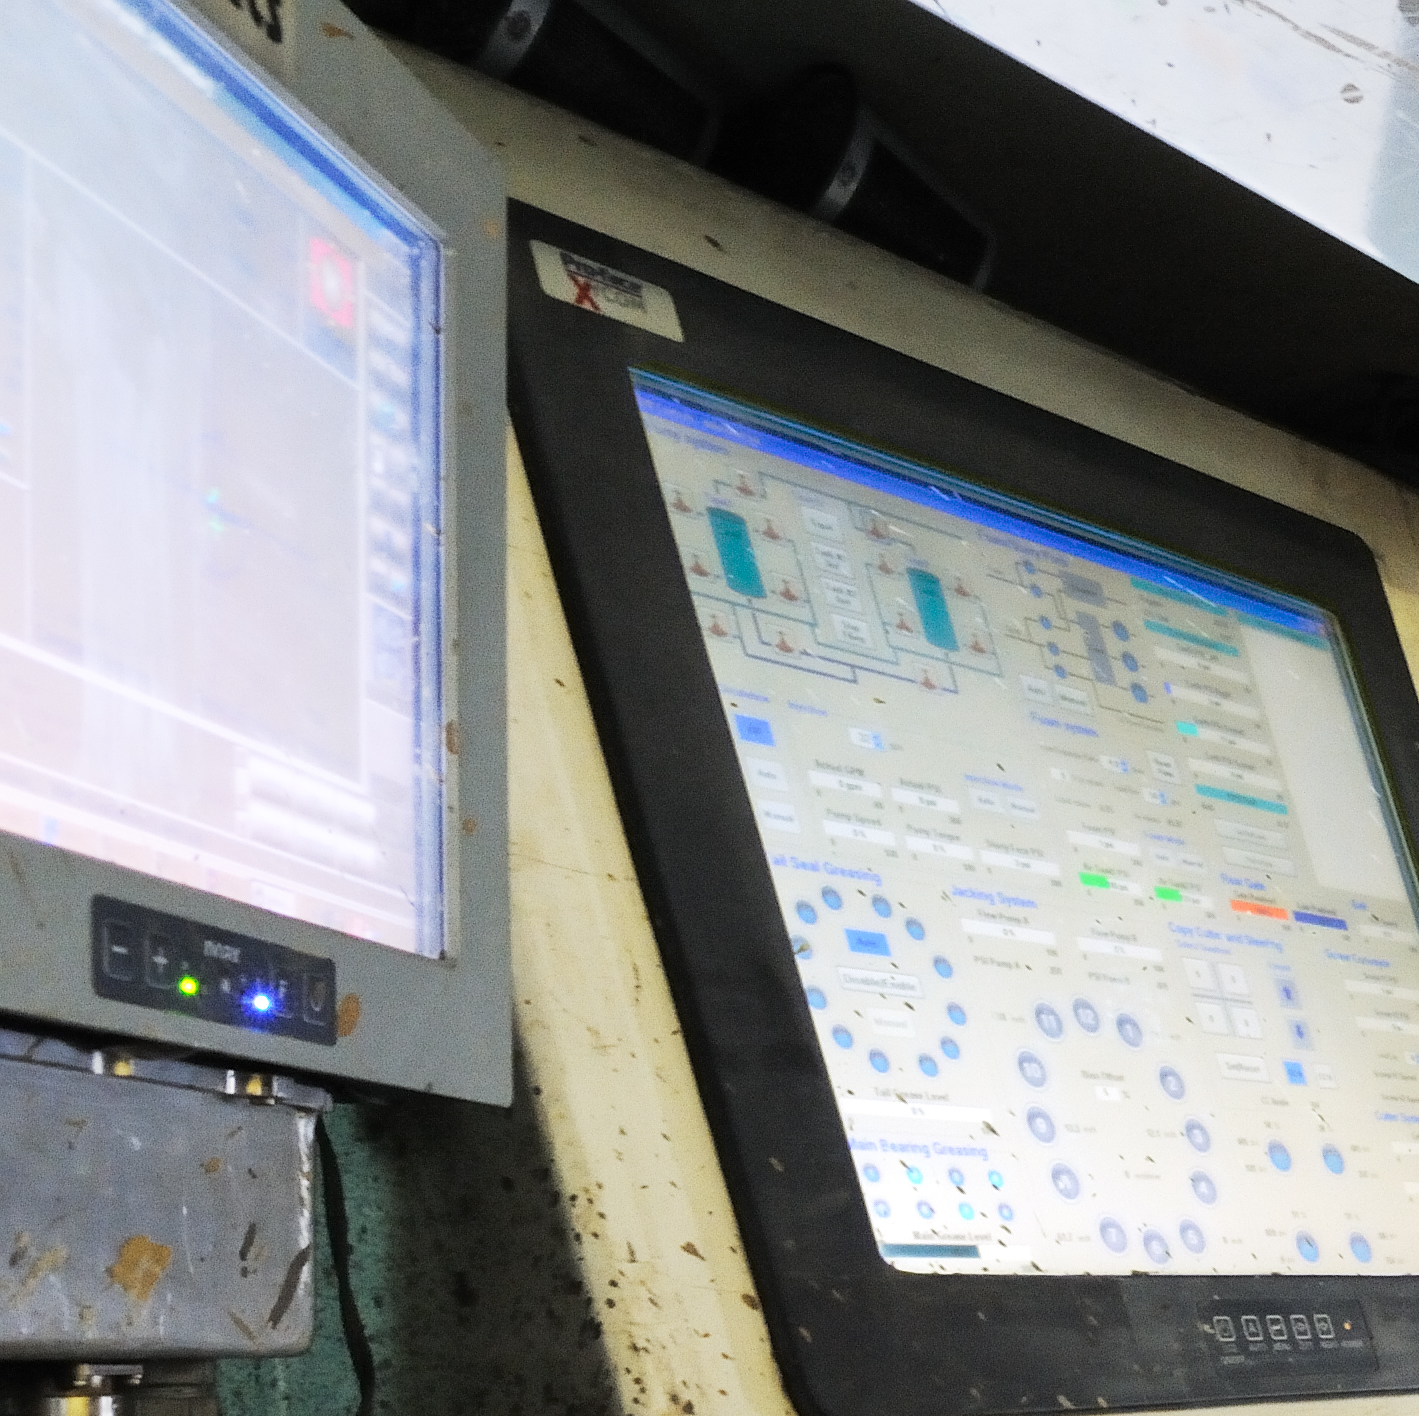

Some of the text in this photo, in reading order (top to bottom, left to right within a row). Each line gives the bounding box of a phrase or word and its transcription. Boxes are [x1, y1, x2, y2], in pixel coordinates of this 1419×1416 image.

[768, 852, 884, 888] ail Seal Greasing
[949, 884, 1039, 910] Jacking System
[1040, 1013, 1059, 1028] 11
[1074, 1006, 1095, 1024] 12
[1021, 1061, 1042, 1078] 10
[1166, 1075, 1179, 1091] 2
[925, 1091, 951, 1102] Level
[877, 1138, 932, 1158] Bearing
[931, 1141, 990, 1162] Greasing
[966, 1232, 993, 1243] Level
